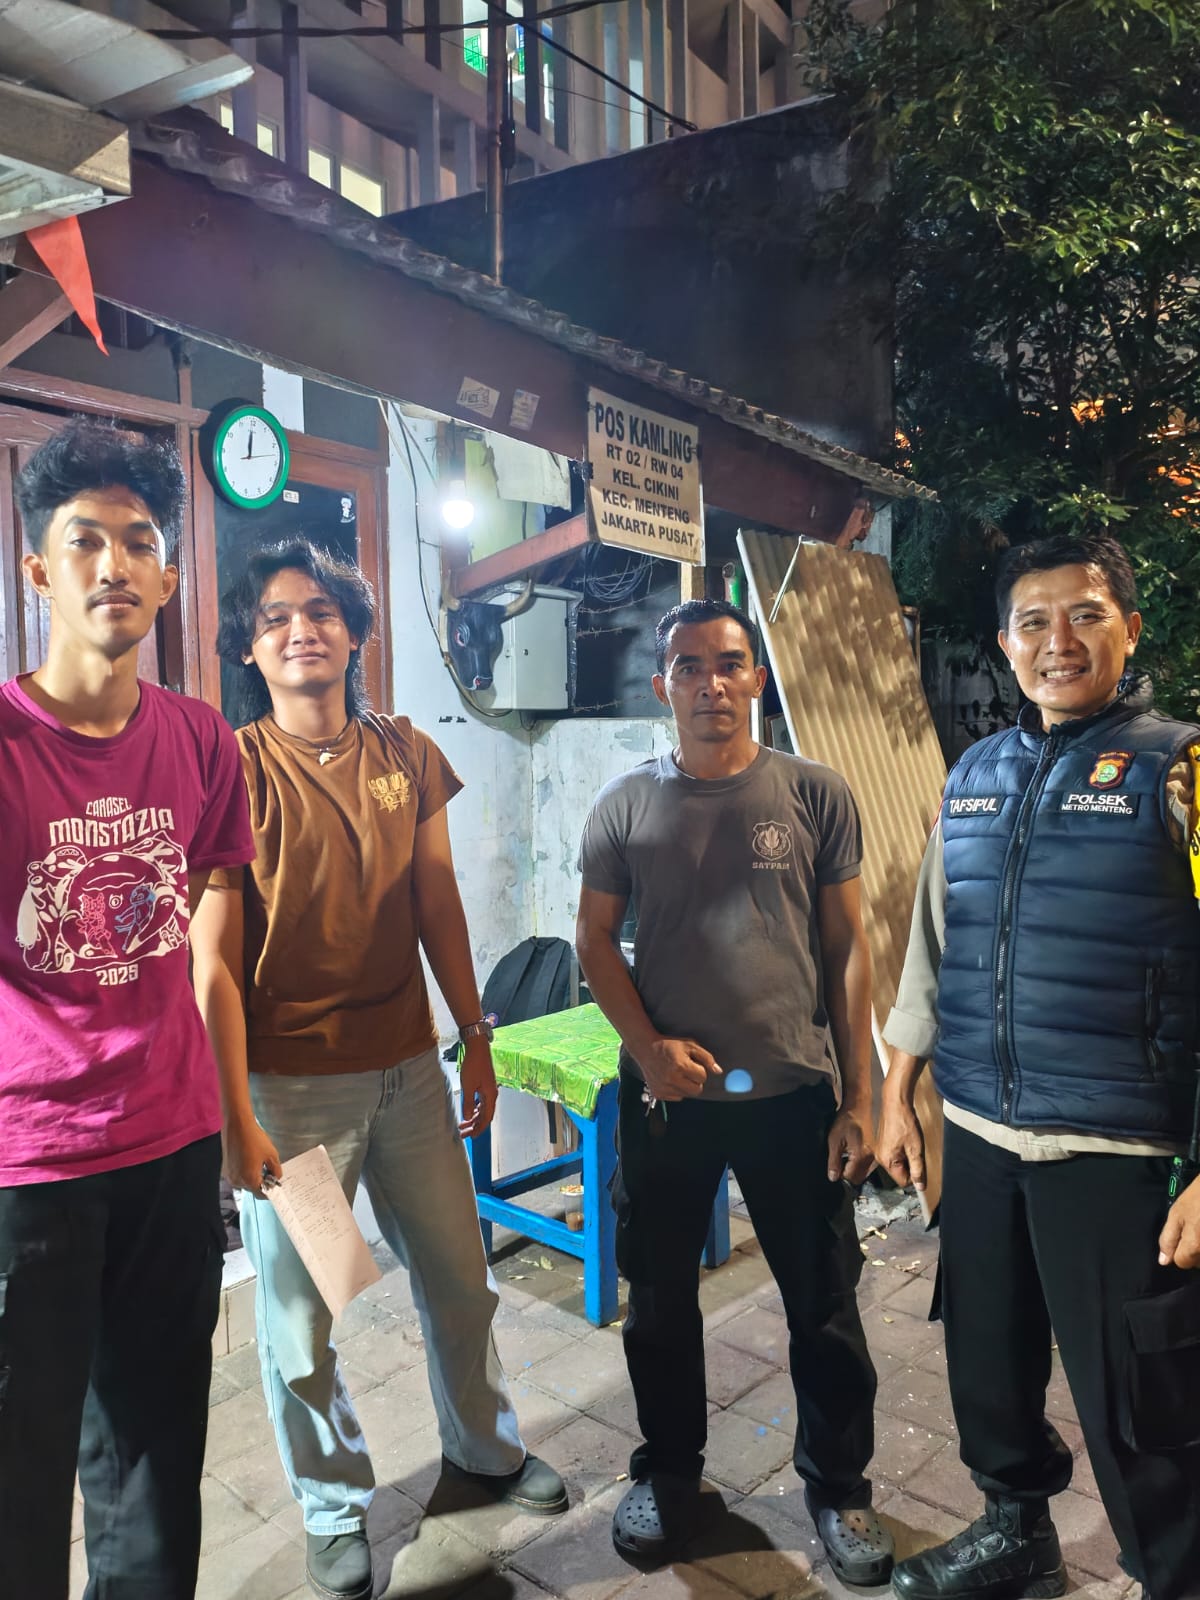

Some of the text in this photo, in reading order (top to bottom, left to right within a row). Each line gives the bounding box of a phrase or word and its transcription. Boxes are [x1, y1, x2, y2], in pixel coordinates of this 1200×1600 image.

[595, 402, 692, 463] POS KAMLING
[606, 443, 684, 480] RT 02 / RW 04
[612, 468, 679, 500] KEL. CIKINI
[602, 489, 690, 524] KEC. MENTENG
[601, 511, 694, 546] JAKARTA PUSAT
[86, 796, 133, 818] CARASEL
[949, 797, 997, 814] TAFSIPUL
[1061, 804, 1133, 815] METRO MENTENG
[1067, 794, 1128, 807] POLSEK
[96, 963, 139, 986] 2025
